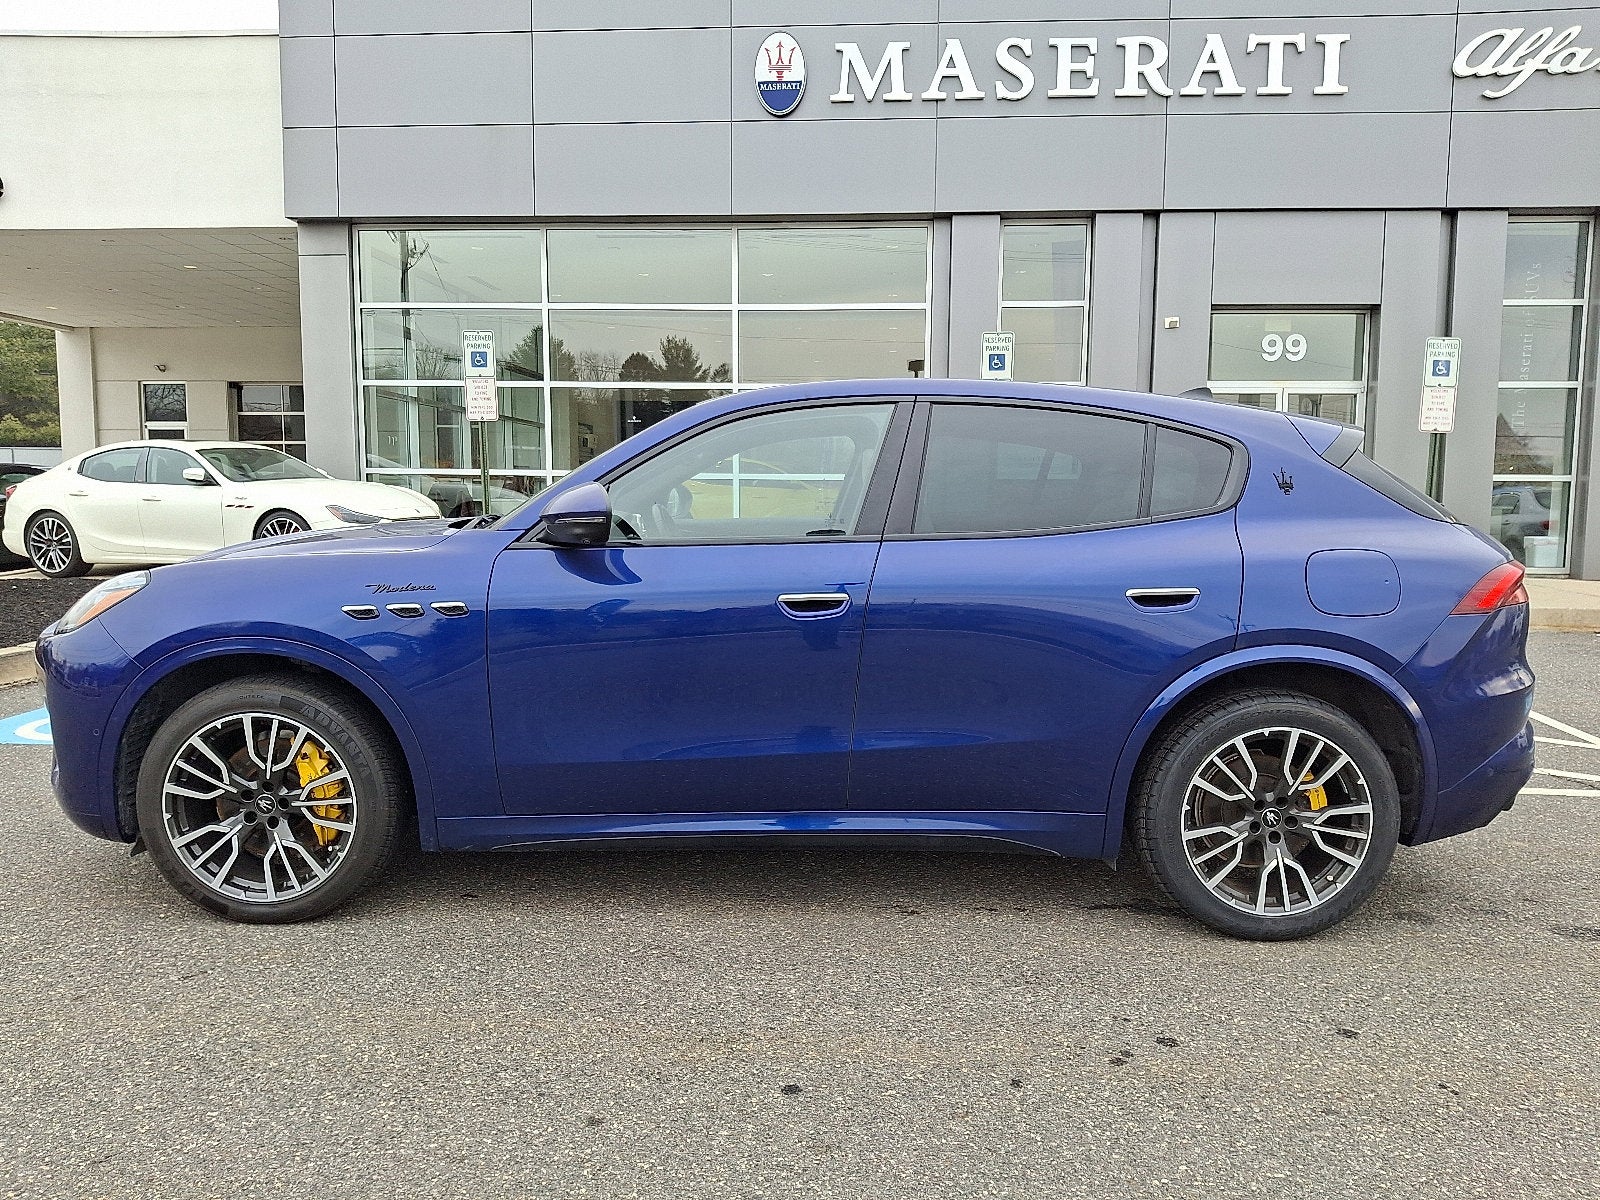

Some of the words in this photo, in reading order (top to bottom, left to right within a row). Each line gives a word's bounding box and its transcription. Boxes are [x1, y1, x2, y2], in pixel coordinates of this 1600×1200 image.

[829, 33, 1351, 102] MASERATI
[1452, 25, 1600, 99] Alfa
[760, 82, 800, 90] MASERATI
[1261, 333, 1308, 362] 99
[1428, 342, 1458, 350] RESERVED
[1429, 350, 1456, 358] PARKING
[365, 583, 437, 595] Modena
